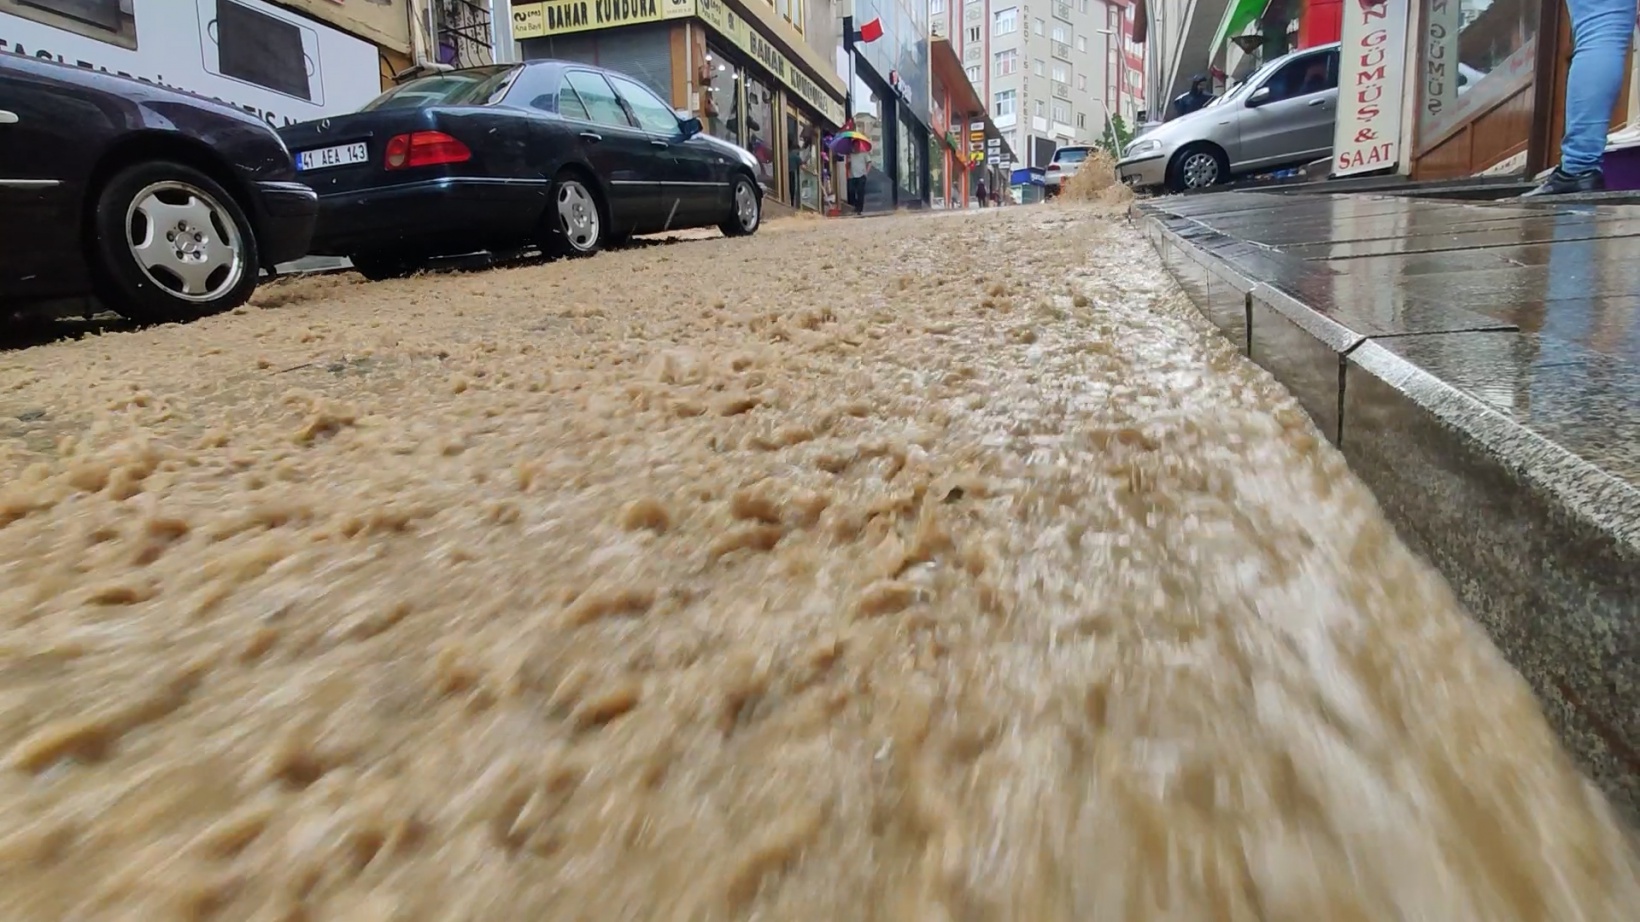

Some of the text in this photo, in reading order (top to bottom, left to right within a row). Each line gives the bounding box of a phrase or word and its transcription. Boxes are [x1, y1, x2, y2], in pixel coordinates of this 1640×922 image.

[547, 2, 588, 30] BAHAR
[595, 0, 657, 24] KUNDURA
[750, 31, 785, 78] BAHAR
[1356, 29, 1388, 122] GÜMÜŞ
[1353, 128, 1379, 143] &
[303, 144, 366, 168] 41 AEA 143
[1338, 142, 1394, 170] SAAT
